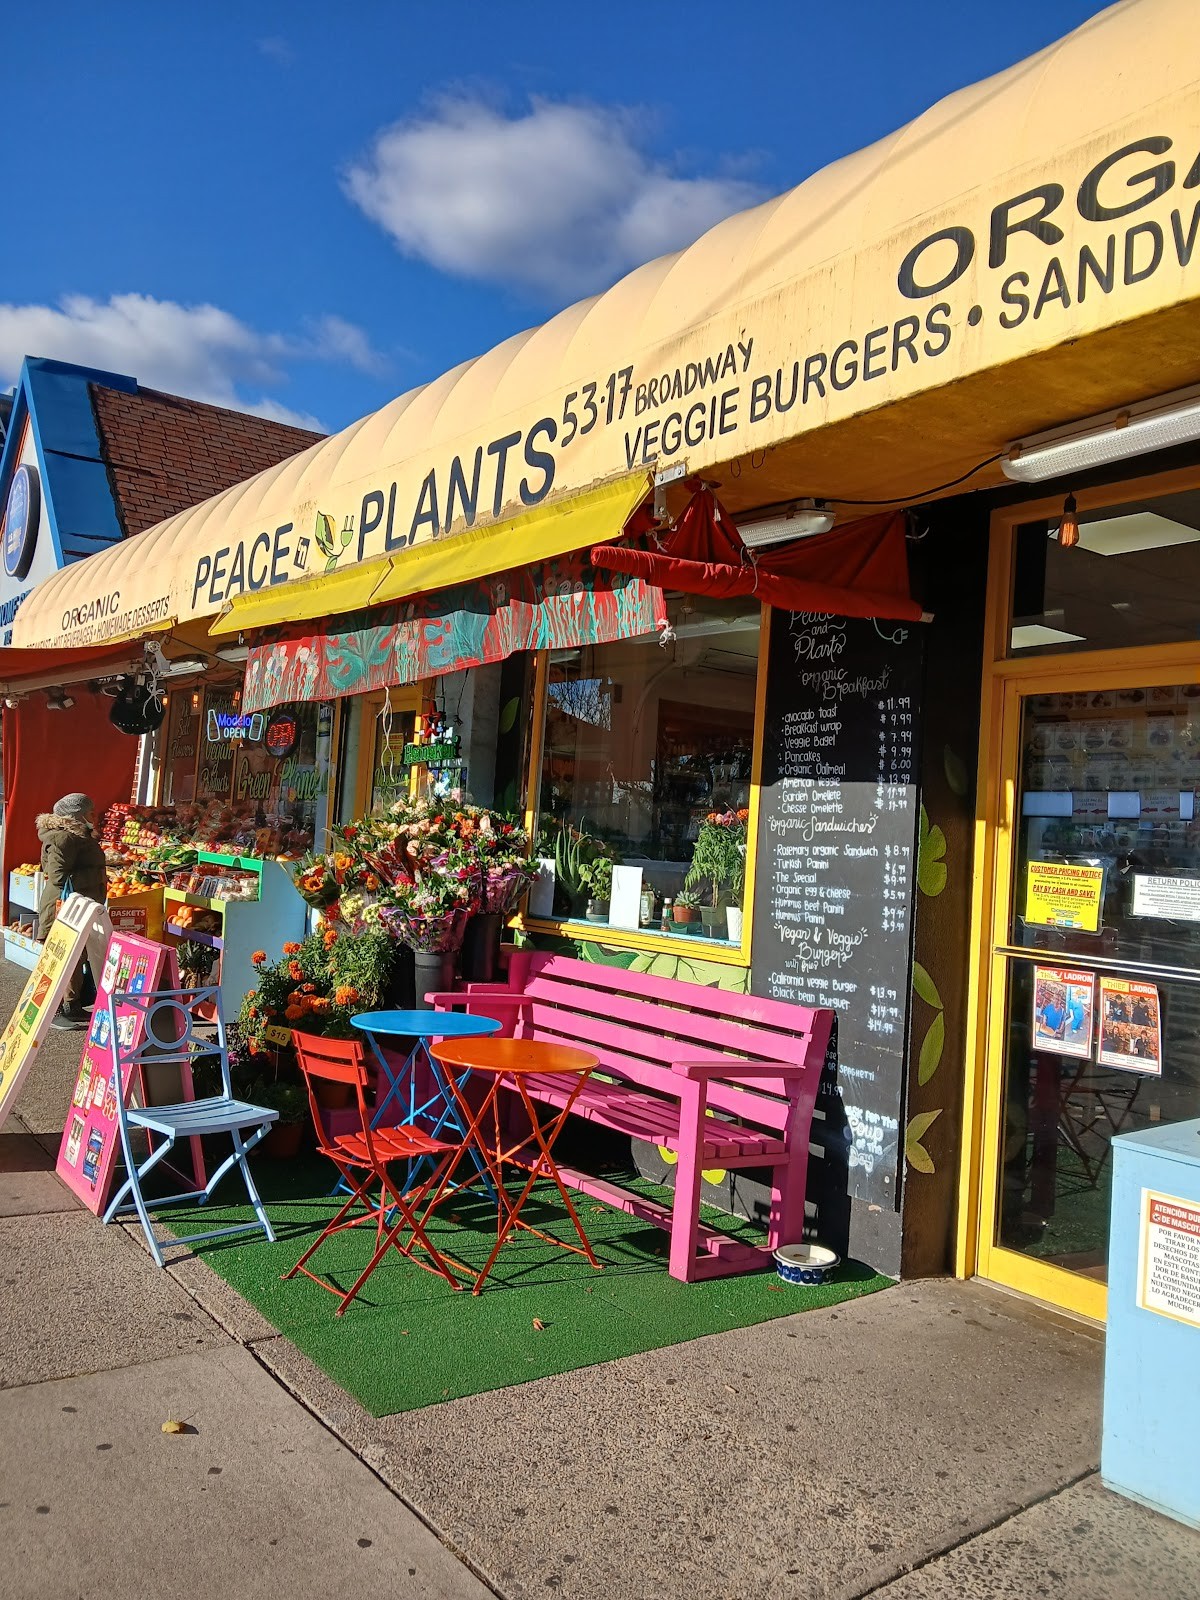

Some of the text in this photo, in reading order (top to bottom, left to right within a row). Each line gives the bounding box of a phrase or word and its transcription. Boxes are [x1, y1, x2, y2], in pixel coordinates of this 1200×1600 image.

[898, 136, 1200, 299] ORG
[635, 337, 754, 417] BROADWAY
[625, 387, 740, 470] VEGGIE
[750, 303, 952, 424] BURGERS
[191, 522, 294, 610] PEACE
[357, 418, 558, 562] PLANTS
[62, 591, 120, 631] ORGANIC
[96, 610, 132, 641] HOMEMADE
[132, 595, 170, 629] DESSERTS
[811, 622, 828, 635] and
[795, 633, 847, 663] Plants
[822, 669, 890, 701] Breakfast
[818, 703, 838, 718] toast
[218, 713, 251, 727] Modelo
[223, 727, 246, 739] OPEN
[784, 721, 819, 736] Breakfast
[820, 721, 842, 735] wrap
[784, 737, 811, 749] Veggie
[813, 735, 837, 747] Bagel
[403, 742, 459, 765] Heineken
[784, 752, 821, 763] Pancakes
[784, 763, 813, 776] Organic
[816, 762, 846, 776] Oatmeal
[238, 757, 271, 801] Green
[782, 778, 815, 790] American
[782, 791, 808, 803] Garden
[770, 815, 877, 841] organic Sandwiches
[777, 844, 810, 857] Rosemary
[813, 846, 840, 857] organic
[844, 843, 879, 857] Sandwich
[777, 859, 803, 870] Turkish
[807, 858, 830, 870] Panini
[776, 872, 790, 883] The
[793, 872, 817, 884] Special
[1031, 866, 1058, 876] CUSTOMER
[1059, 868, 1080, 878] PRICING
[1081, 870, 1103, 879] NOTICE
[1147, 877, 1178, 887] RETURN
[776, 884, 802, 899] Organic
[805, 887, 818, 897] egg
[1033, 884, 1043, 893] PAY
[1044, 886, 1052, 894] BY
[1052, 887, 1067, 896] CASH
[1067, 888, 1079, 898] AND
[1080, 889, 1096, 899] SAVE!
[111, 909, 146, 918] BASKETS
[775, 898, 802, 909] Hummus
[823, 902, 844, 915] Panini
[804, 912, 825, 925] Panini
[778, 925, 865, 952] Vegan & Veggie
[795, 942, 853, 969] Burgers
[785, 959, 819, 973] with fries
[771, 972, 804, 987] California
[832, 979, 857, 993] Burger
[1064, 971, 1093, 983] LADRON
[772, 986, 795, 1000] Black
[798, 990, 816, 1003] bean
[1106, 981, 1158, 996] THIEF LADRON
[86, 1150, 99, 1165] ICE
[1154, 1203, 1187, 1221] ATENCIÓN
[1161, 1215, 1171, 1226] DE
[1158, 1227, 1172, 1238] POR
[1173, 1231, 1195, 1245] FAVOR
[1153, 1242, 1198, 1262] DESECHOS DE
[1165, 1238, 1200, 1254] TIRAR LOS
[1153, 1257, 1163, 1266] EN
[1163, 1260, 1180, 1271] ESTE
[1164, 1253, 1200, 1270] MASCOTAS
[1152, 1271, 1162, 1281] LA
[1155, 1265, 1169, 1276] DOR
[1170, 1270, 1180, 1279] DE
[1151, 1279, 1182, 1295] NUESTRO
[1151, 1286, 1161, 1296] LO
